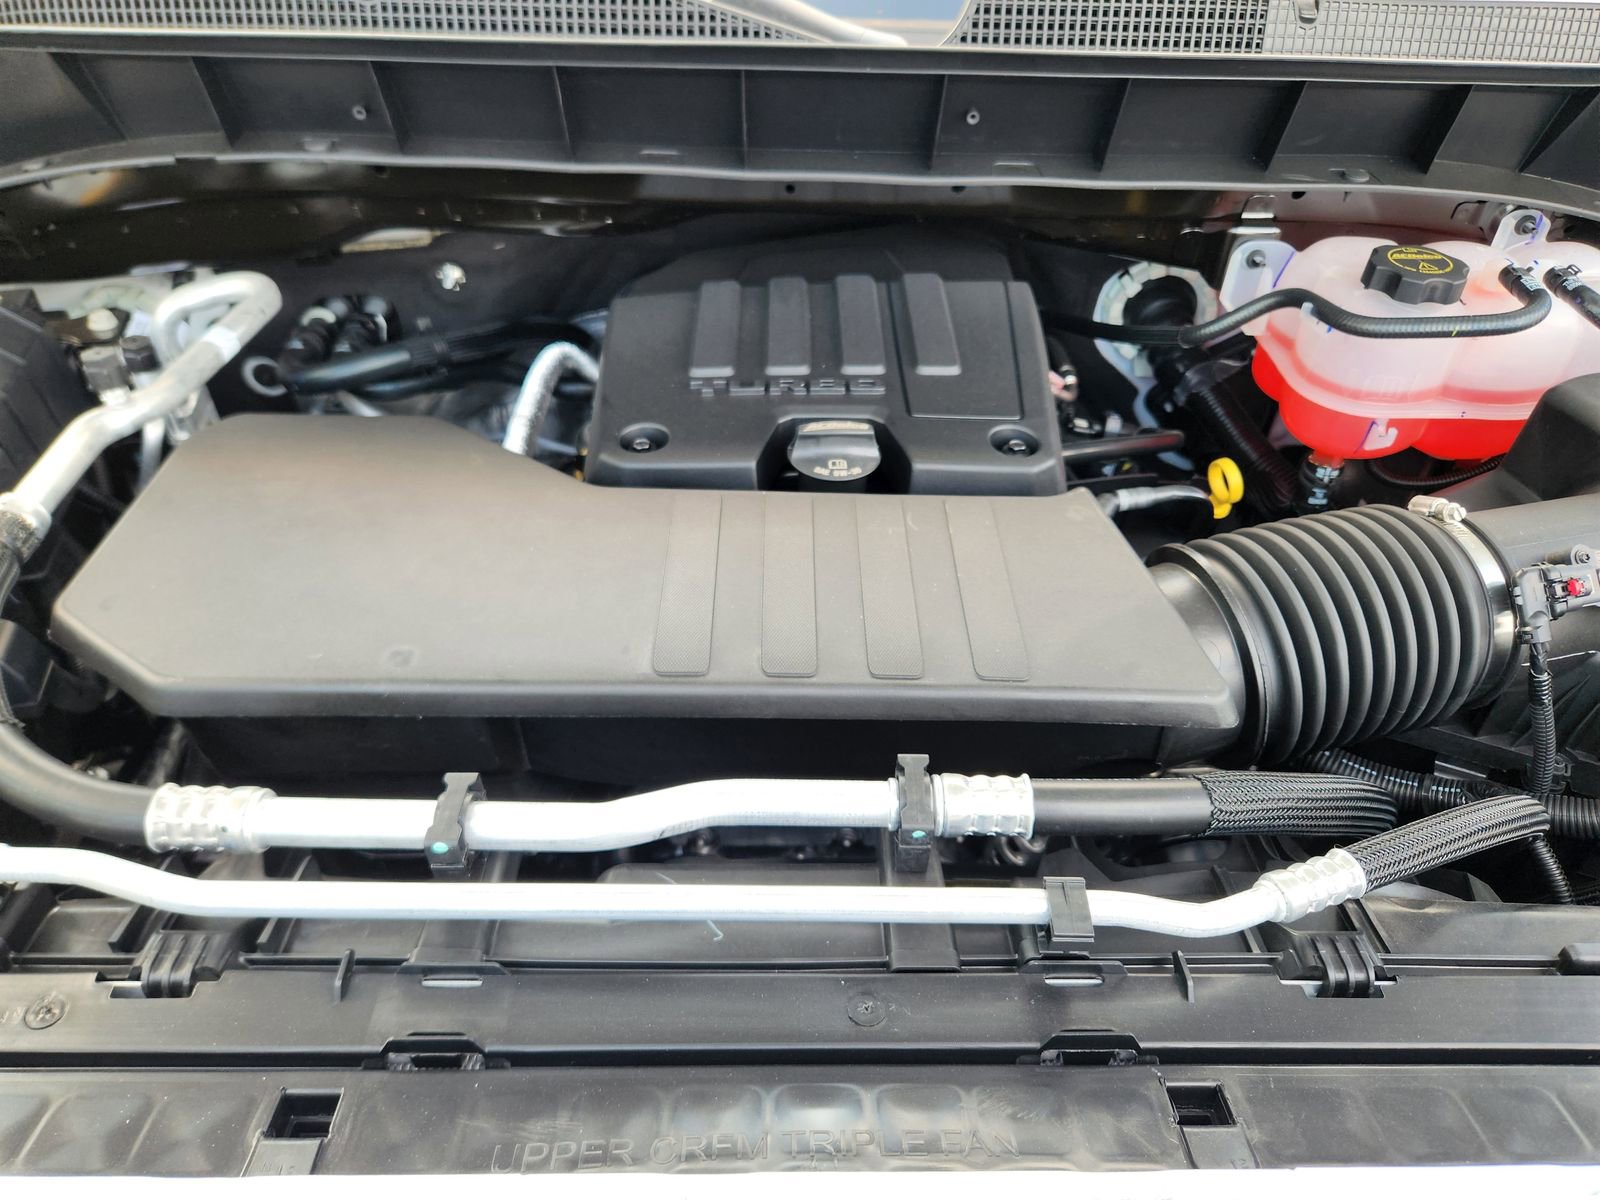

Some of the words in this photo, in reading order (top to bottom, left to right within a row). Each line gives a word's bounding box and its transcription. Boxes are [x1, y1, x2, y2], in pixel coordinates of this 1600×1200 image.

[490, 1138, 635, 1175] UPPER
[649, 1132, 769, 1165] CRFM
[780, 1128, 927, 1158] TRIPLE
[940, 1129, 1022, 1160] FAN
